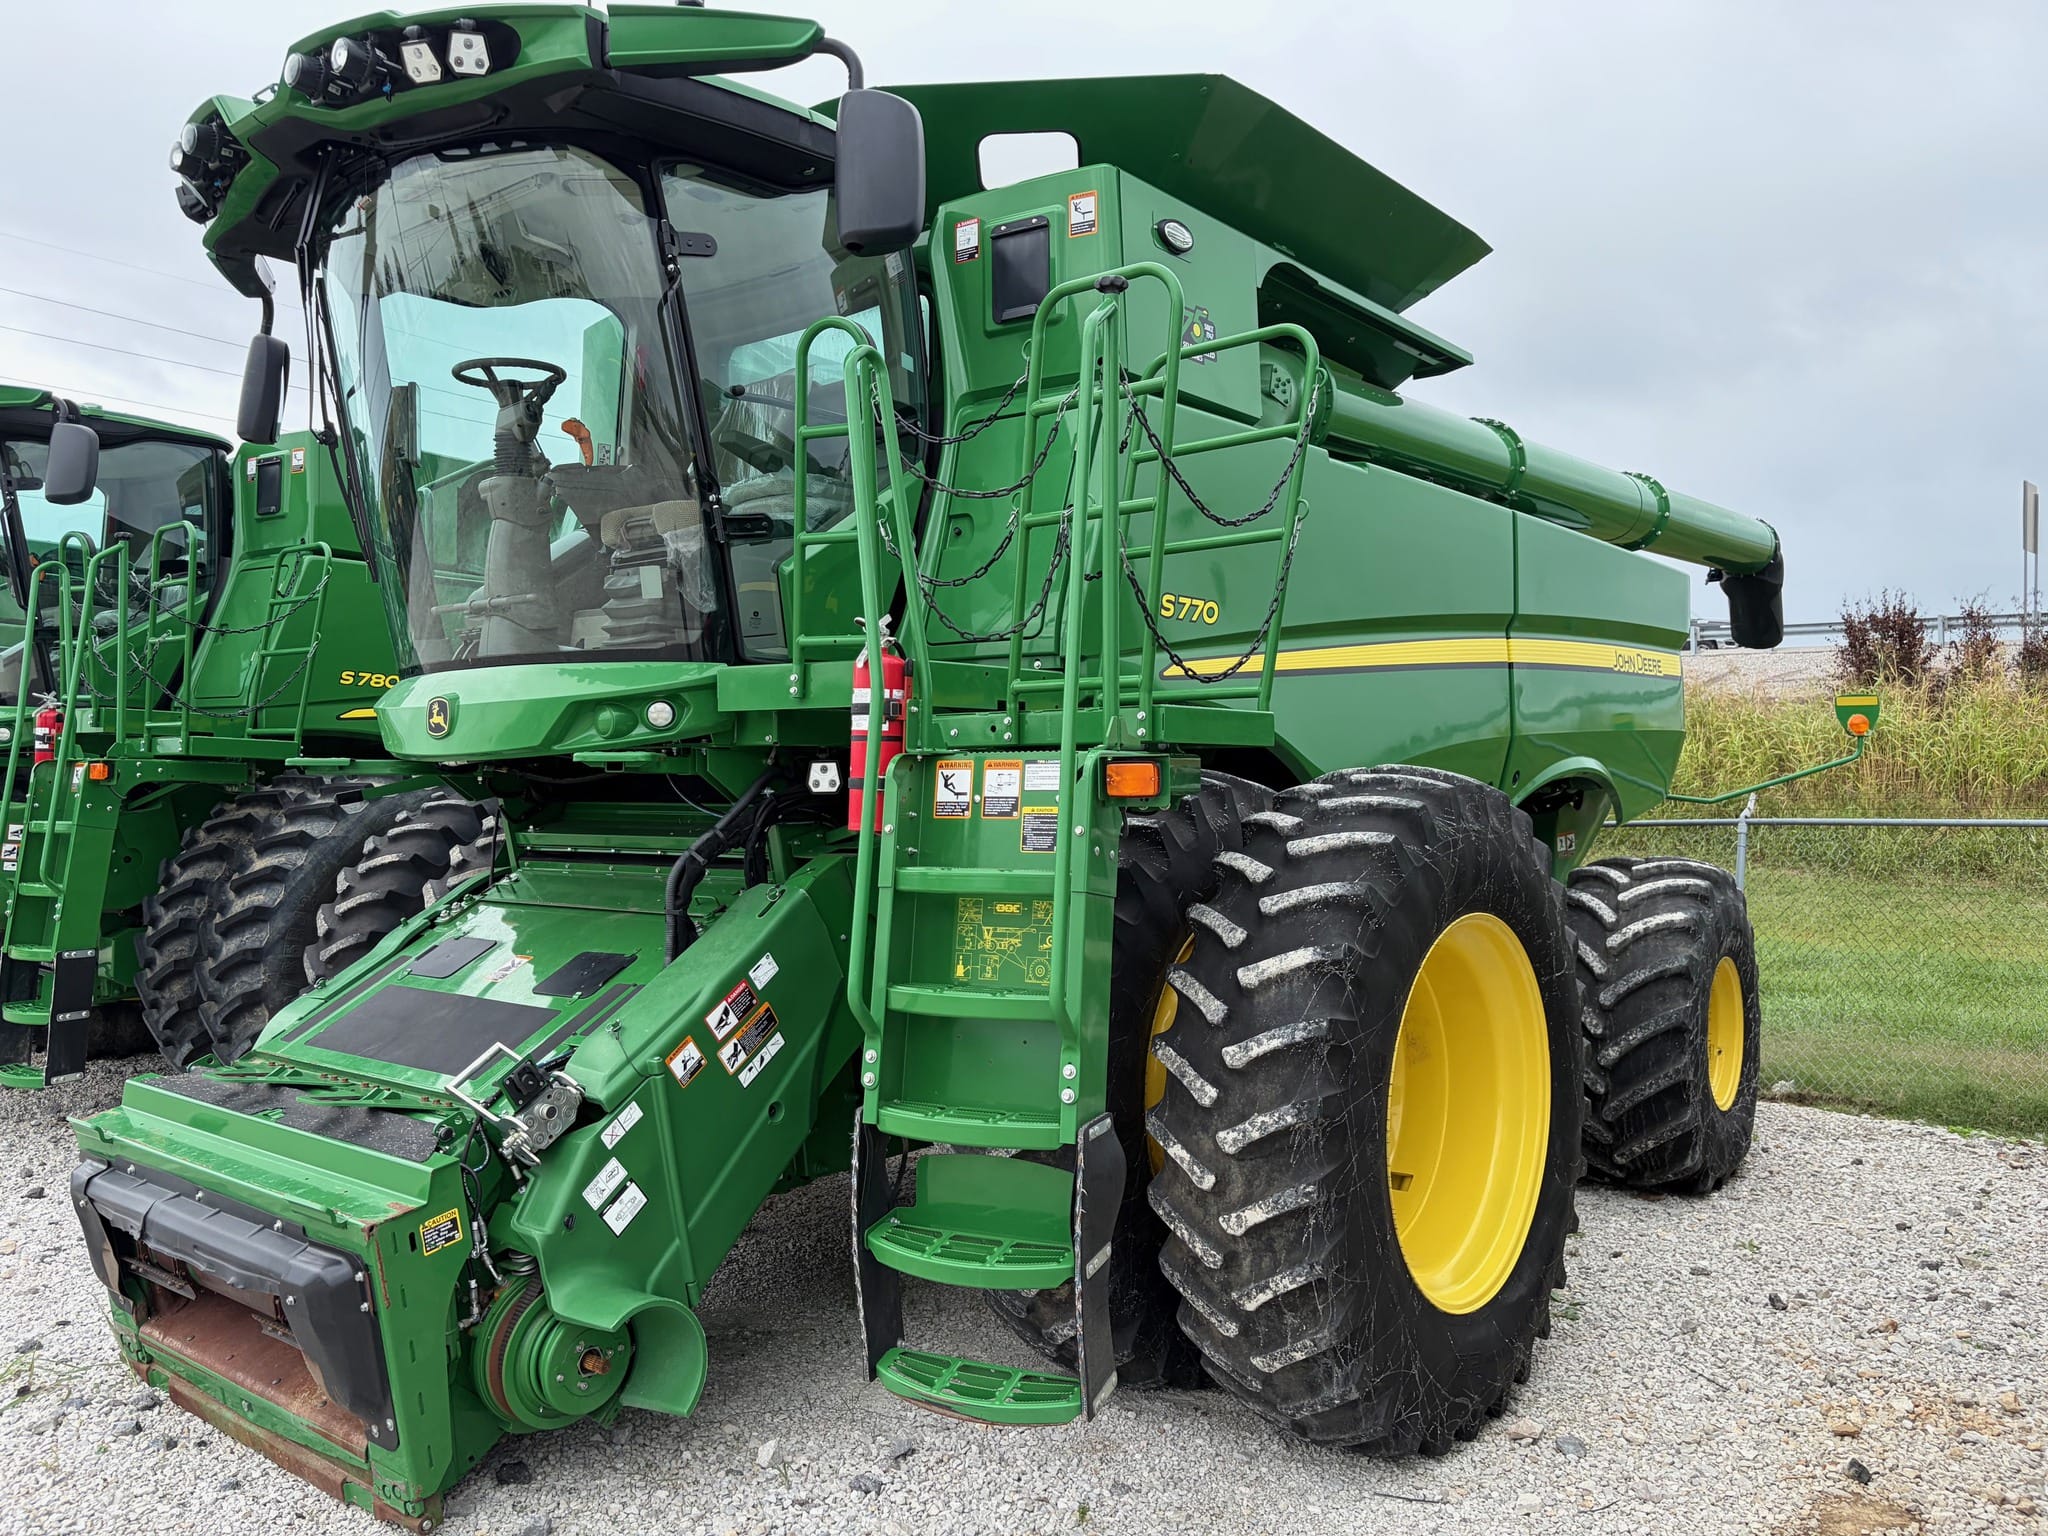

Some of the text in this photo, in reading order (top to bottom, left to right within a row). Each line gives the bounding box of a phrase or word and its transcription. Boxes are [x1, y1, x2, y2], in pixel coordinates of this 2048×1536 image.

[1160, 593, 1219, 625] S770
[1613, 650, 1664, 676] JOHN DEERE
[339, 670, 400, 689] S780
[427, 1210, 457, 1227] CAUTION
